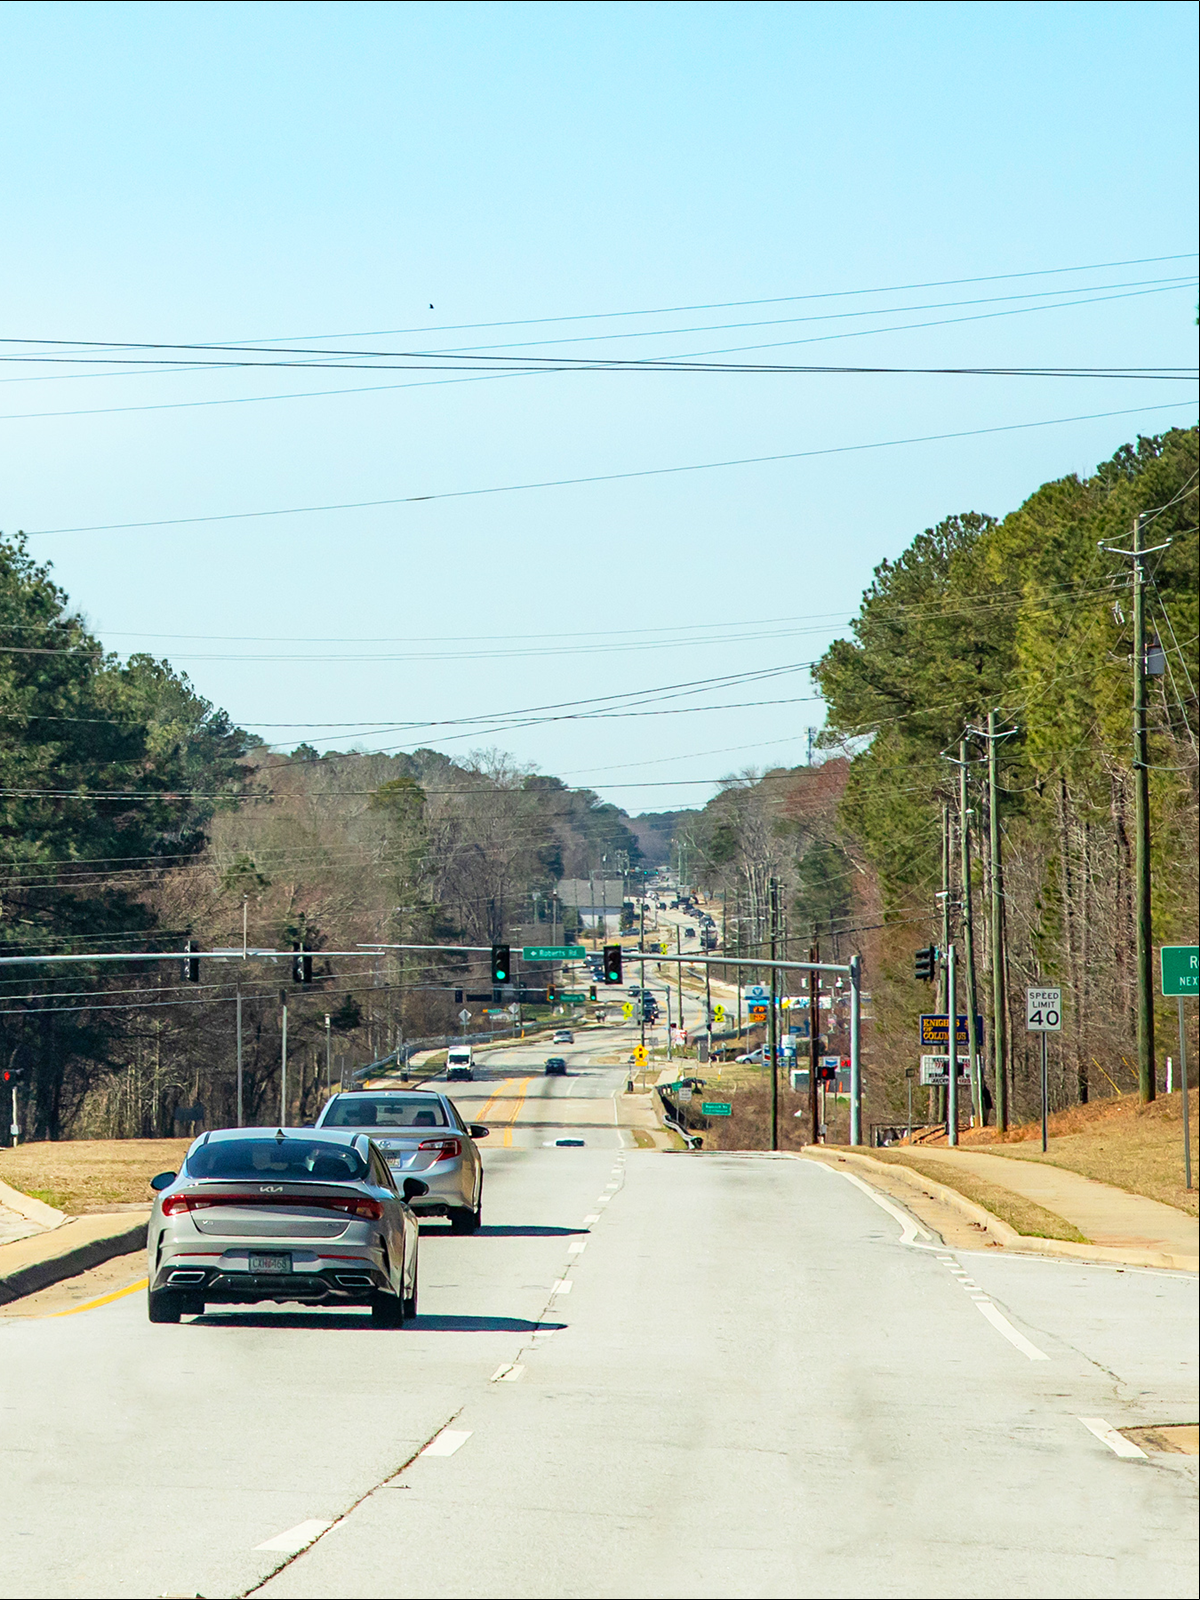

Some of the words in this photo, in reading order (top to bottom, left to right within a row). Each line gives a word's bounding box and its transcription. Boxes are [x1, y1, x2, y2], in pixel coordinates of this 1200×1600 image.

[539, 949, 566, 957] Roberts
[1189, 955, 1199, 969] R
[1179, 976, 1199, 986] NEX
[1029, 992, 1059, 1000] SPEED
[1029, 1009, 1059, 1026] 40
[923, 1018, 960, 1027] KNIGHS
[923, 1031, 967, 1040] COLUMUS
